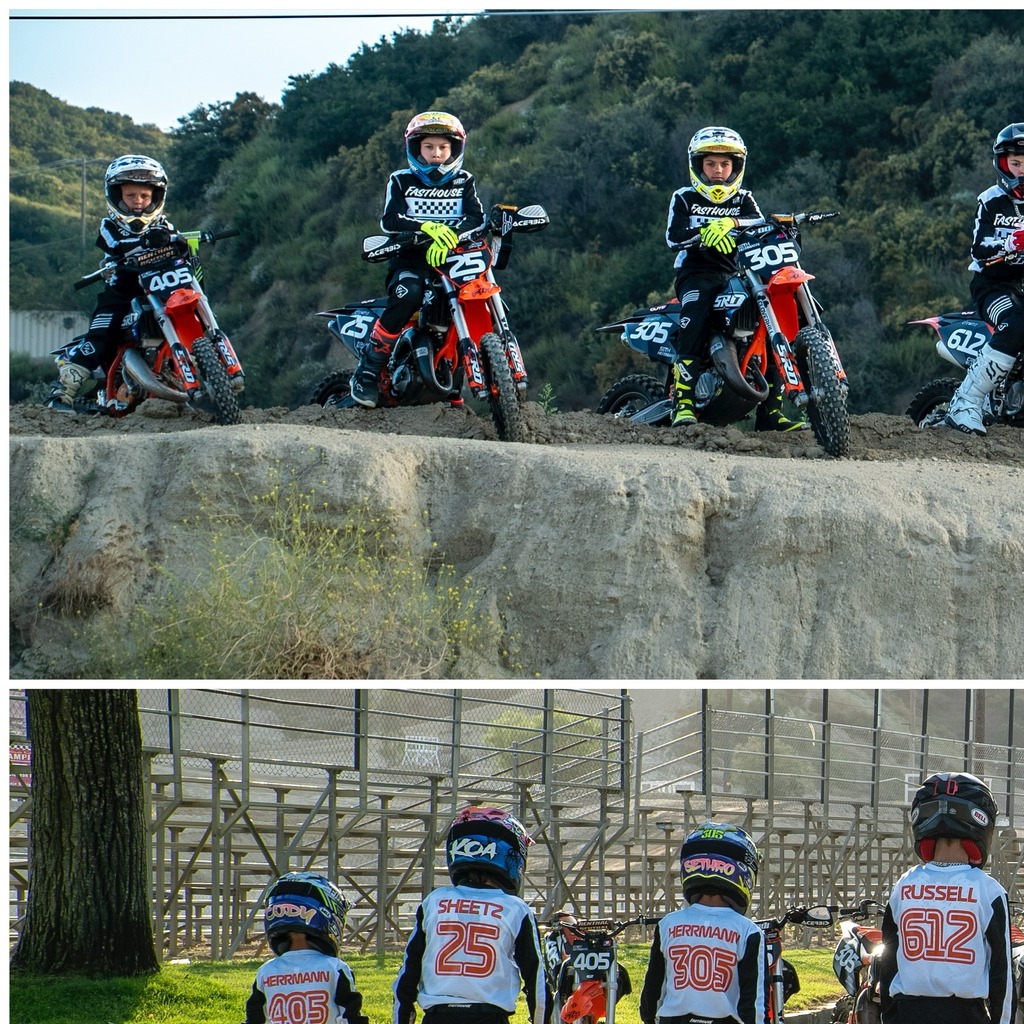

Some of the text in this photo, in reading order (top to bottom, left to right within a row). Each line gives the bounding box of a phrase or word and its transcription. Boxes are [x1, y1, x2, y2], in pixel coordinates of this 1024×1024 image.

[405, 186, 464, 198] FASTHOUSE
[690, 203, 741, 216] FASTHOUSE
[446, 251, 486, 279] 25
[745, 242, 798, 270] 305
[149, 267, 193, 292] 405
[714, 294, 747, 310] SRD
[340, 314, 374, 339] 25
[630, 321, 673, 344] 305
[947, 328, 986, 357] 612
[973, 811, 987, 824] BELL
[701, 829, 724, 840] 305
[450, 838, 498, 860] KOA
[900, 884, 978, 903] RUSSELL
[438, 899, 504, 920] SHEETZ
[668, 924, 741, 945] HERRMANN
[900, 907, 977, 965] 612
[435, 921, 500, 979] 25
[836, 944, 861, 974] 305
[573, 952, 611, 971] 405
[669, 944, 737, 993] 305
[263, 971, 330, 987] HERRMANN
